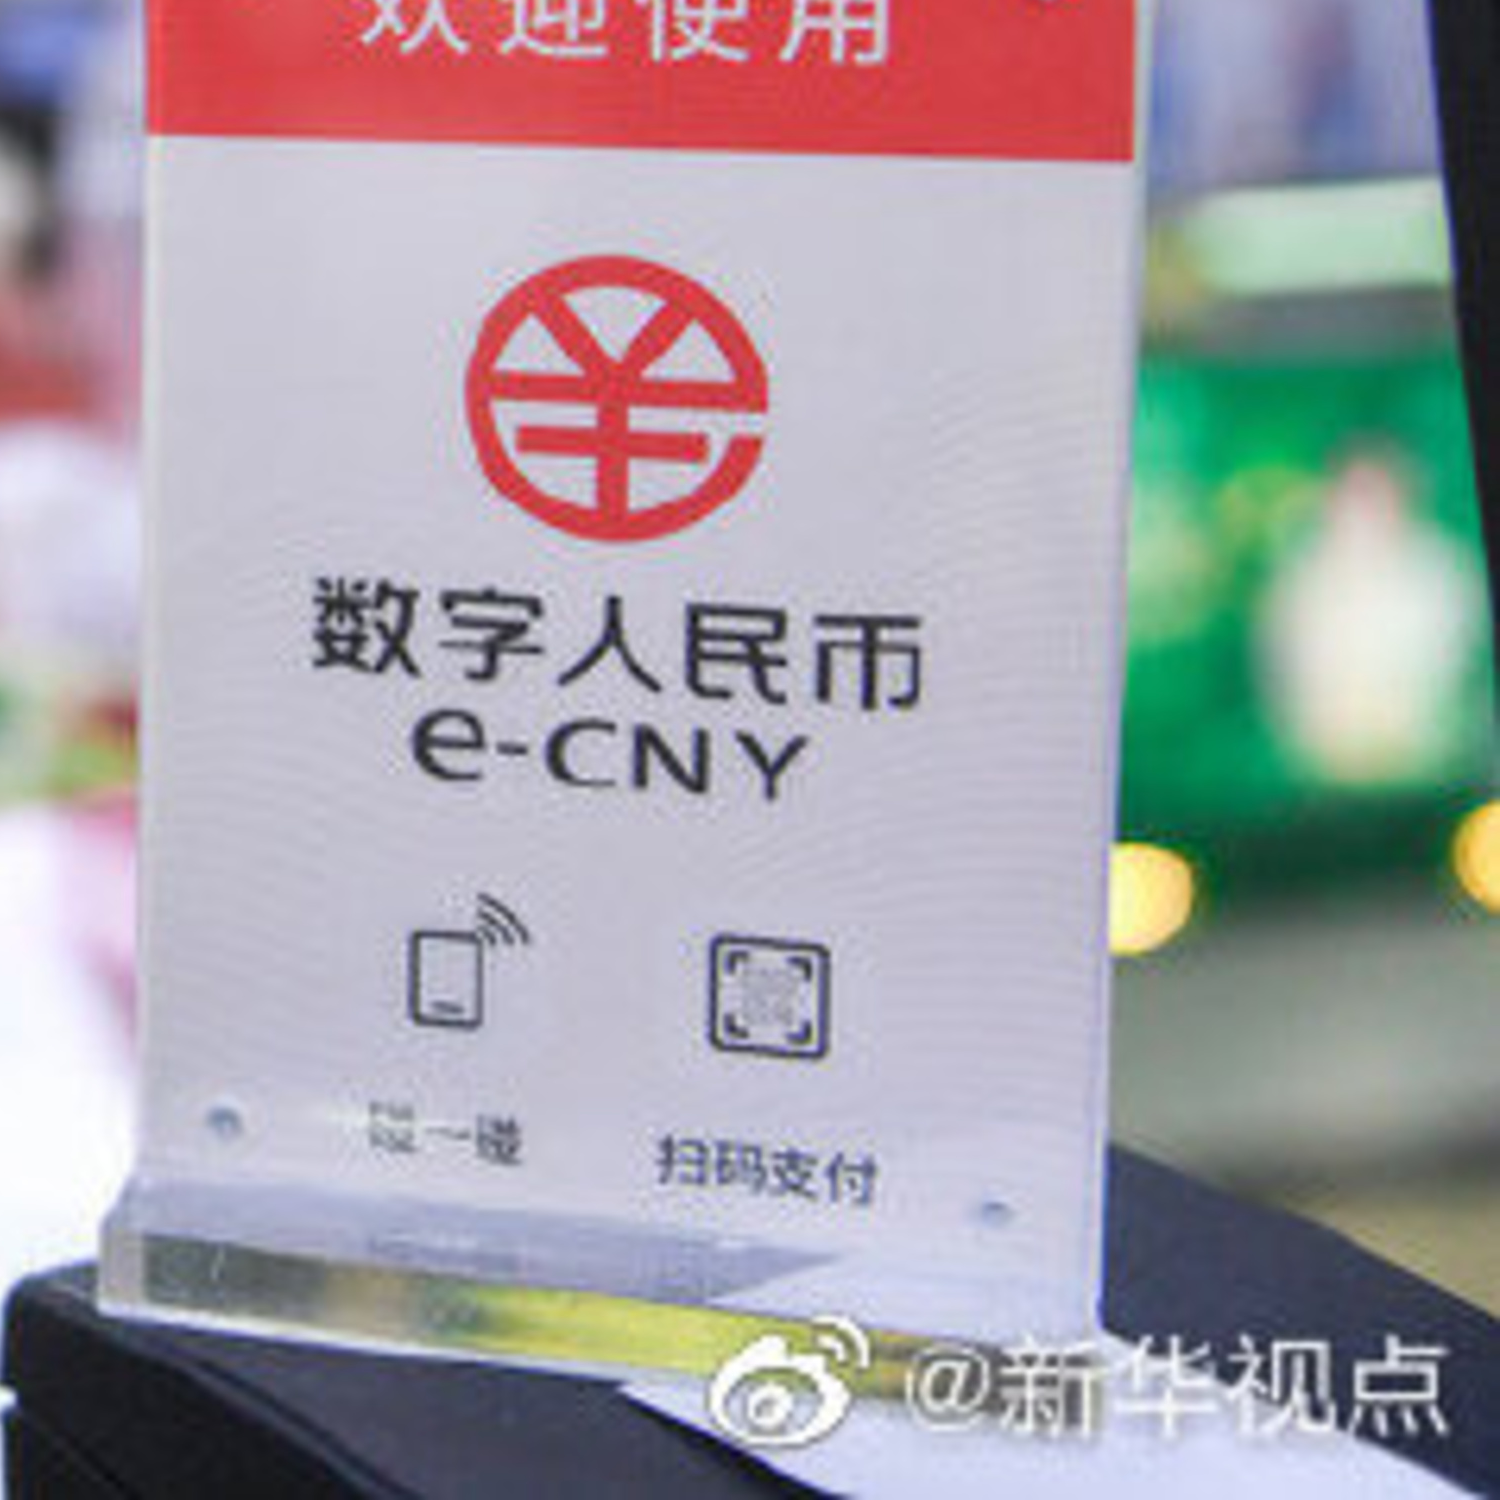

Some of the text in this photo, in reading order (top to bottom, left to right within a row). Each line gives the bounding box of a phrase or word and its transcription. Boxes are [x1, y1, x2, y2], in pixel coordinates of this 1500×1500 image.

[311, 577, 921, 712] 数字人民币
[411, 708, 809, 802] e-CNY
[656, 1133, 877, 1206] 扫码支付
